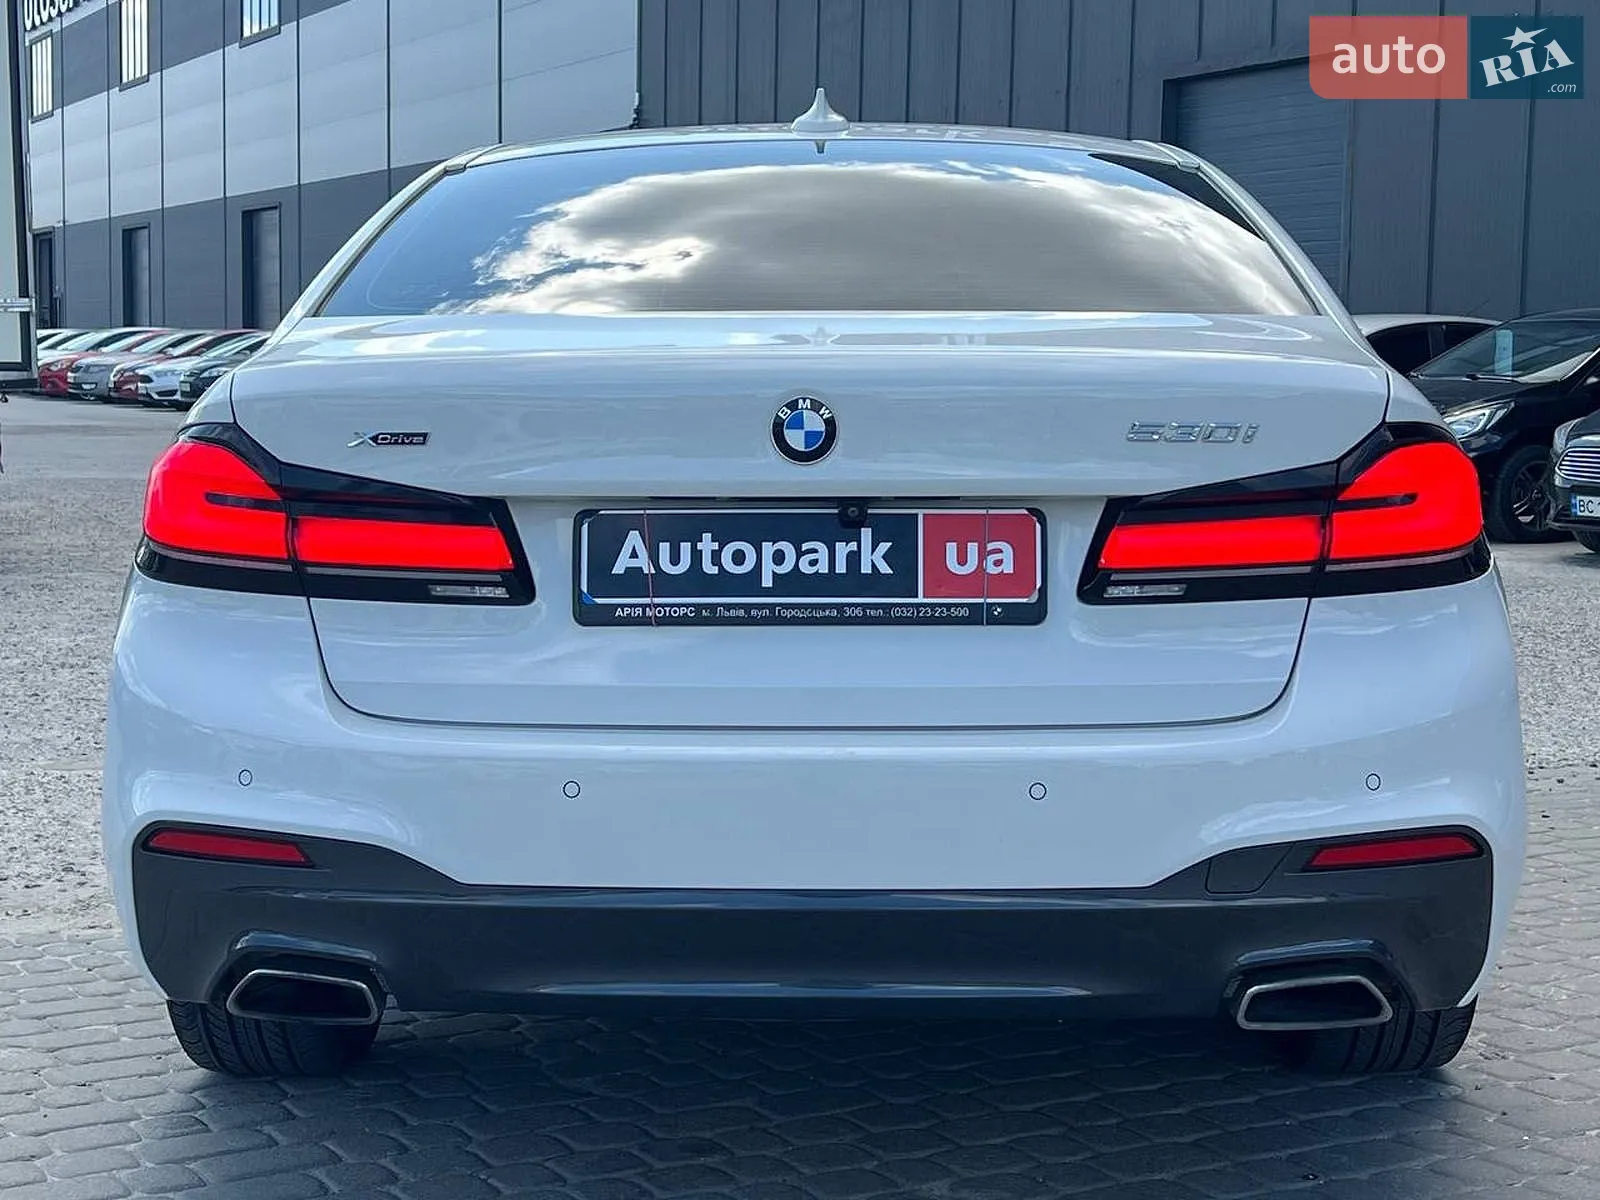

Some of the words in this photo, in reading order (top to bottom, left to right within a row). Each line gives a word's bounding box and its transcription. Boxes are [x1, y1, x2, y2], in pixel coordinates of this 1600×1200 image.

[778, 399, 833, 420] BMW
[1126, 422, 1261, 443] 530i
[611, 527, 893, 588] Autopark
[945, 541, 1015, 575] ua
[615, 607, 642, 617] АРІЯ
[843, 607, 863, 617] 306
[919, 607, 969, 617] 23-23-500
